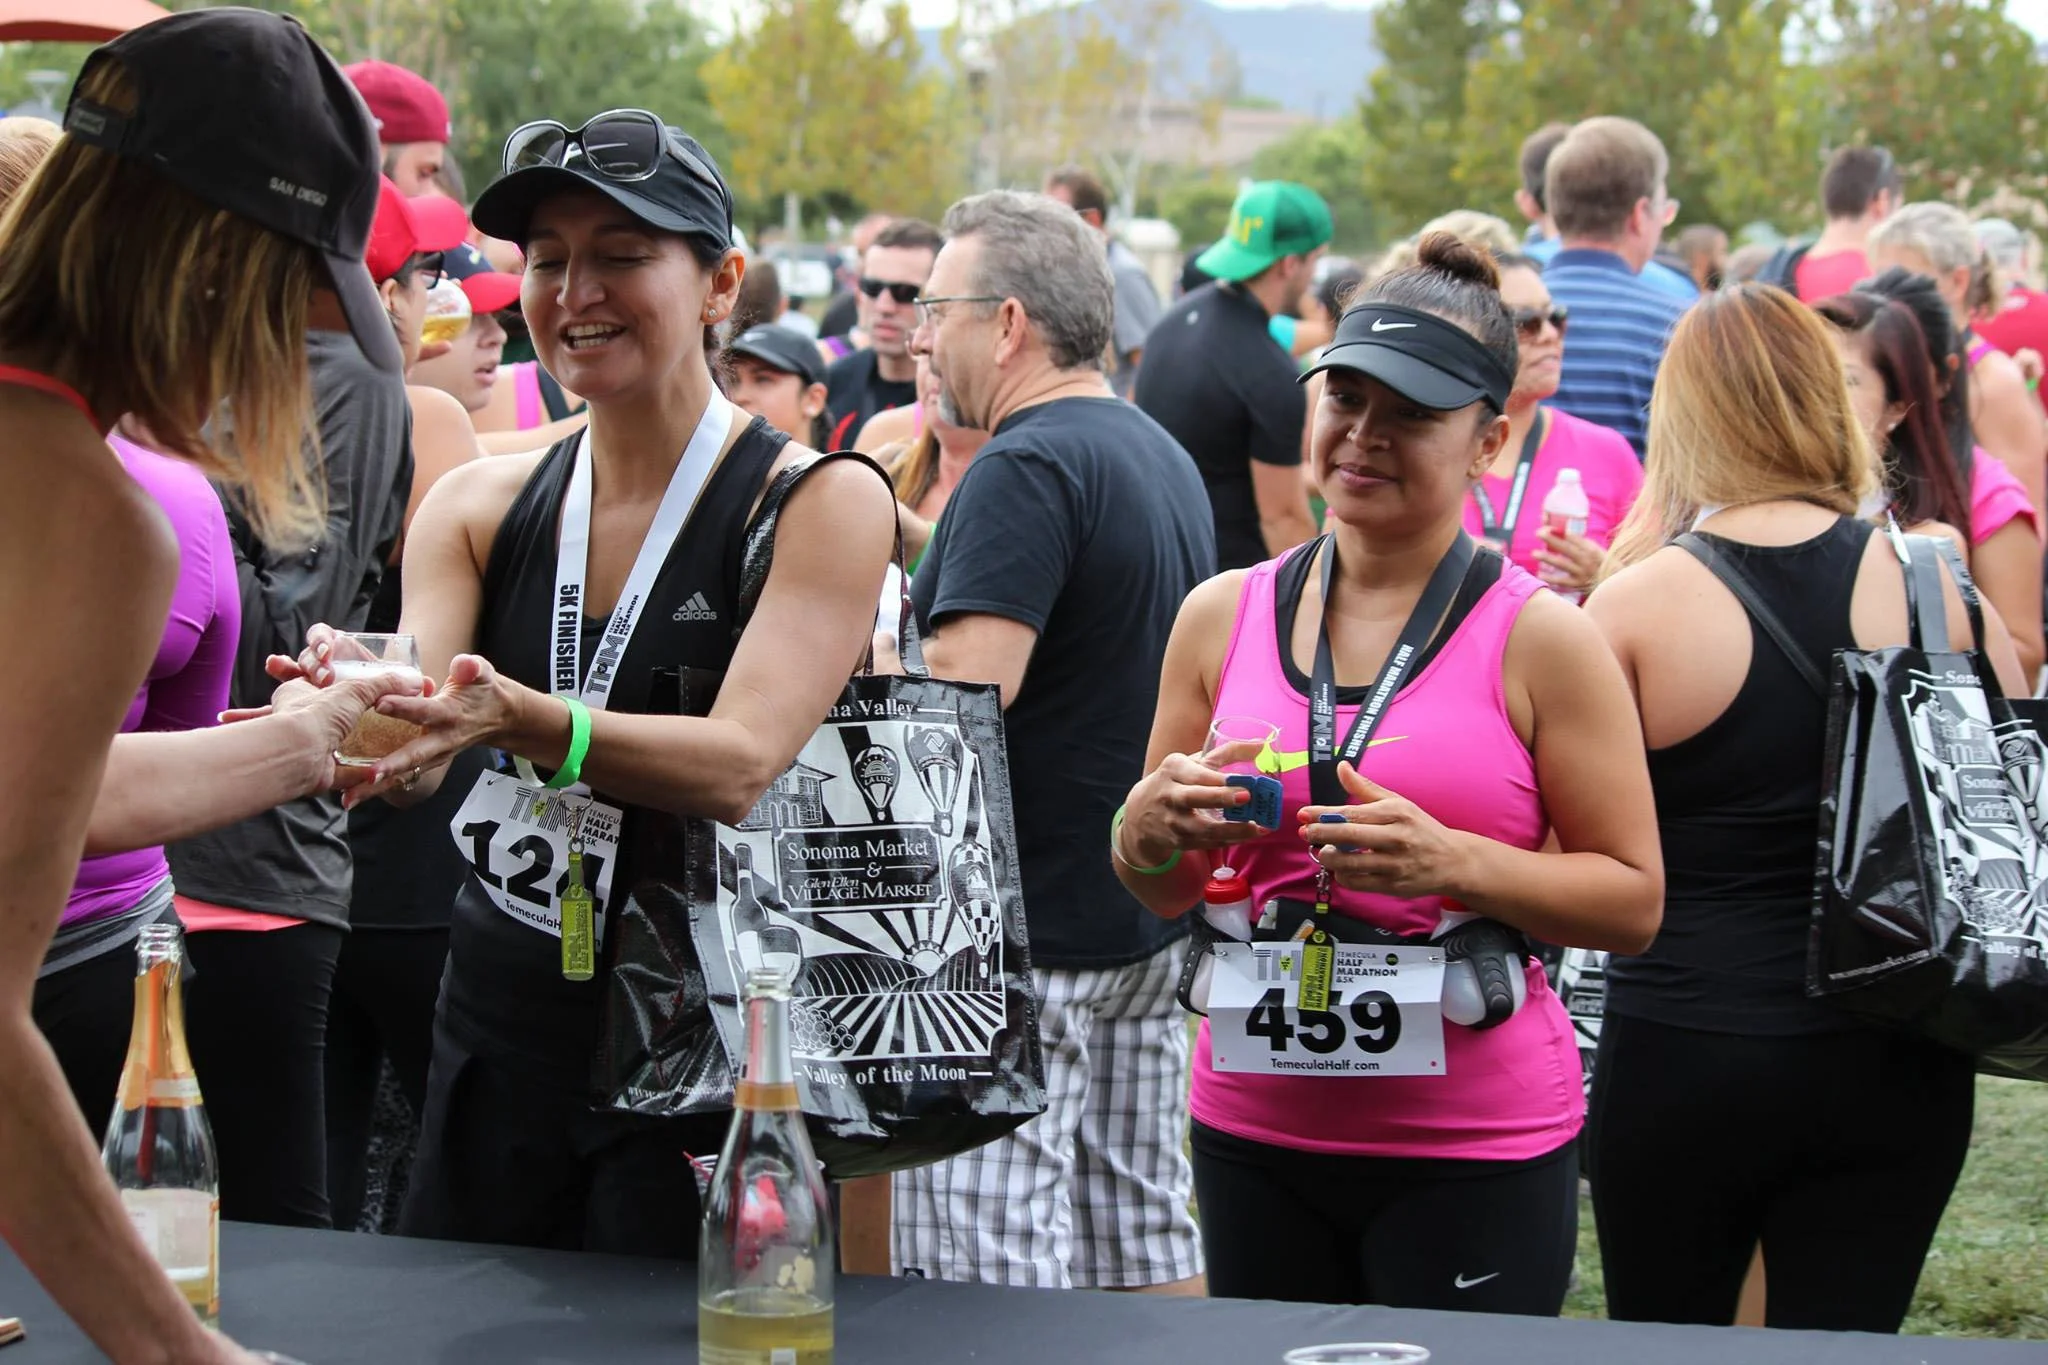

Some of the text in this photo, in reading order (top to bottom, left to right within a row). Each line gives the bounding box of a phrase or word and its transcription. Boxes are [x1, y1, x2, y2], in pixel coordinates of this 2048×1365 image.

[269, 176, 328, 207] SAN DIEGO
[672, 610, 717, 621] adidas
[556, 584, 580, 691] 5K FINISHER
[858, 698, 914, 720] Valley
[1344, 644, 1415, 758] HALF MARATHON FINISHER
[585, 815, 613, 832] HALF
[588, 808, 621, 826] TEMECU
[787, 838, 930, 861] Sonoma Market
[866, 862, 883, 878] &
[788, 881, 933, 901] VILLAGE MARKET
[803, 876, 860, 889] Glen Ellen
[1337, 951, 1377, 959] TEMECULA
[1337, 958, 1364, 967] HALF
[1336, 967, 1398, 977] MARATHON
[1245, 987, 1403, 1054] 459
[1270, 1058, 1380, 1072] TemeculaHalf.com
[803, 1064, 967, 1090] Valley of the Moon
